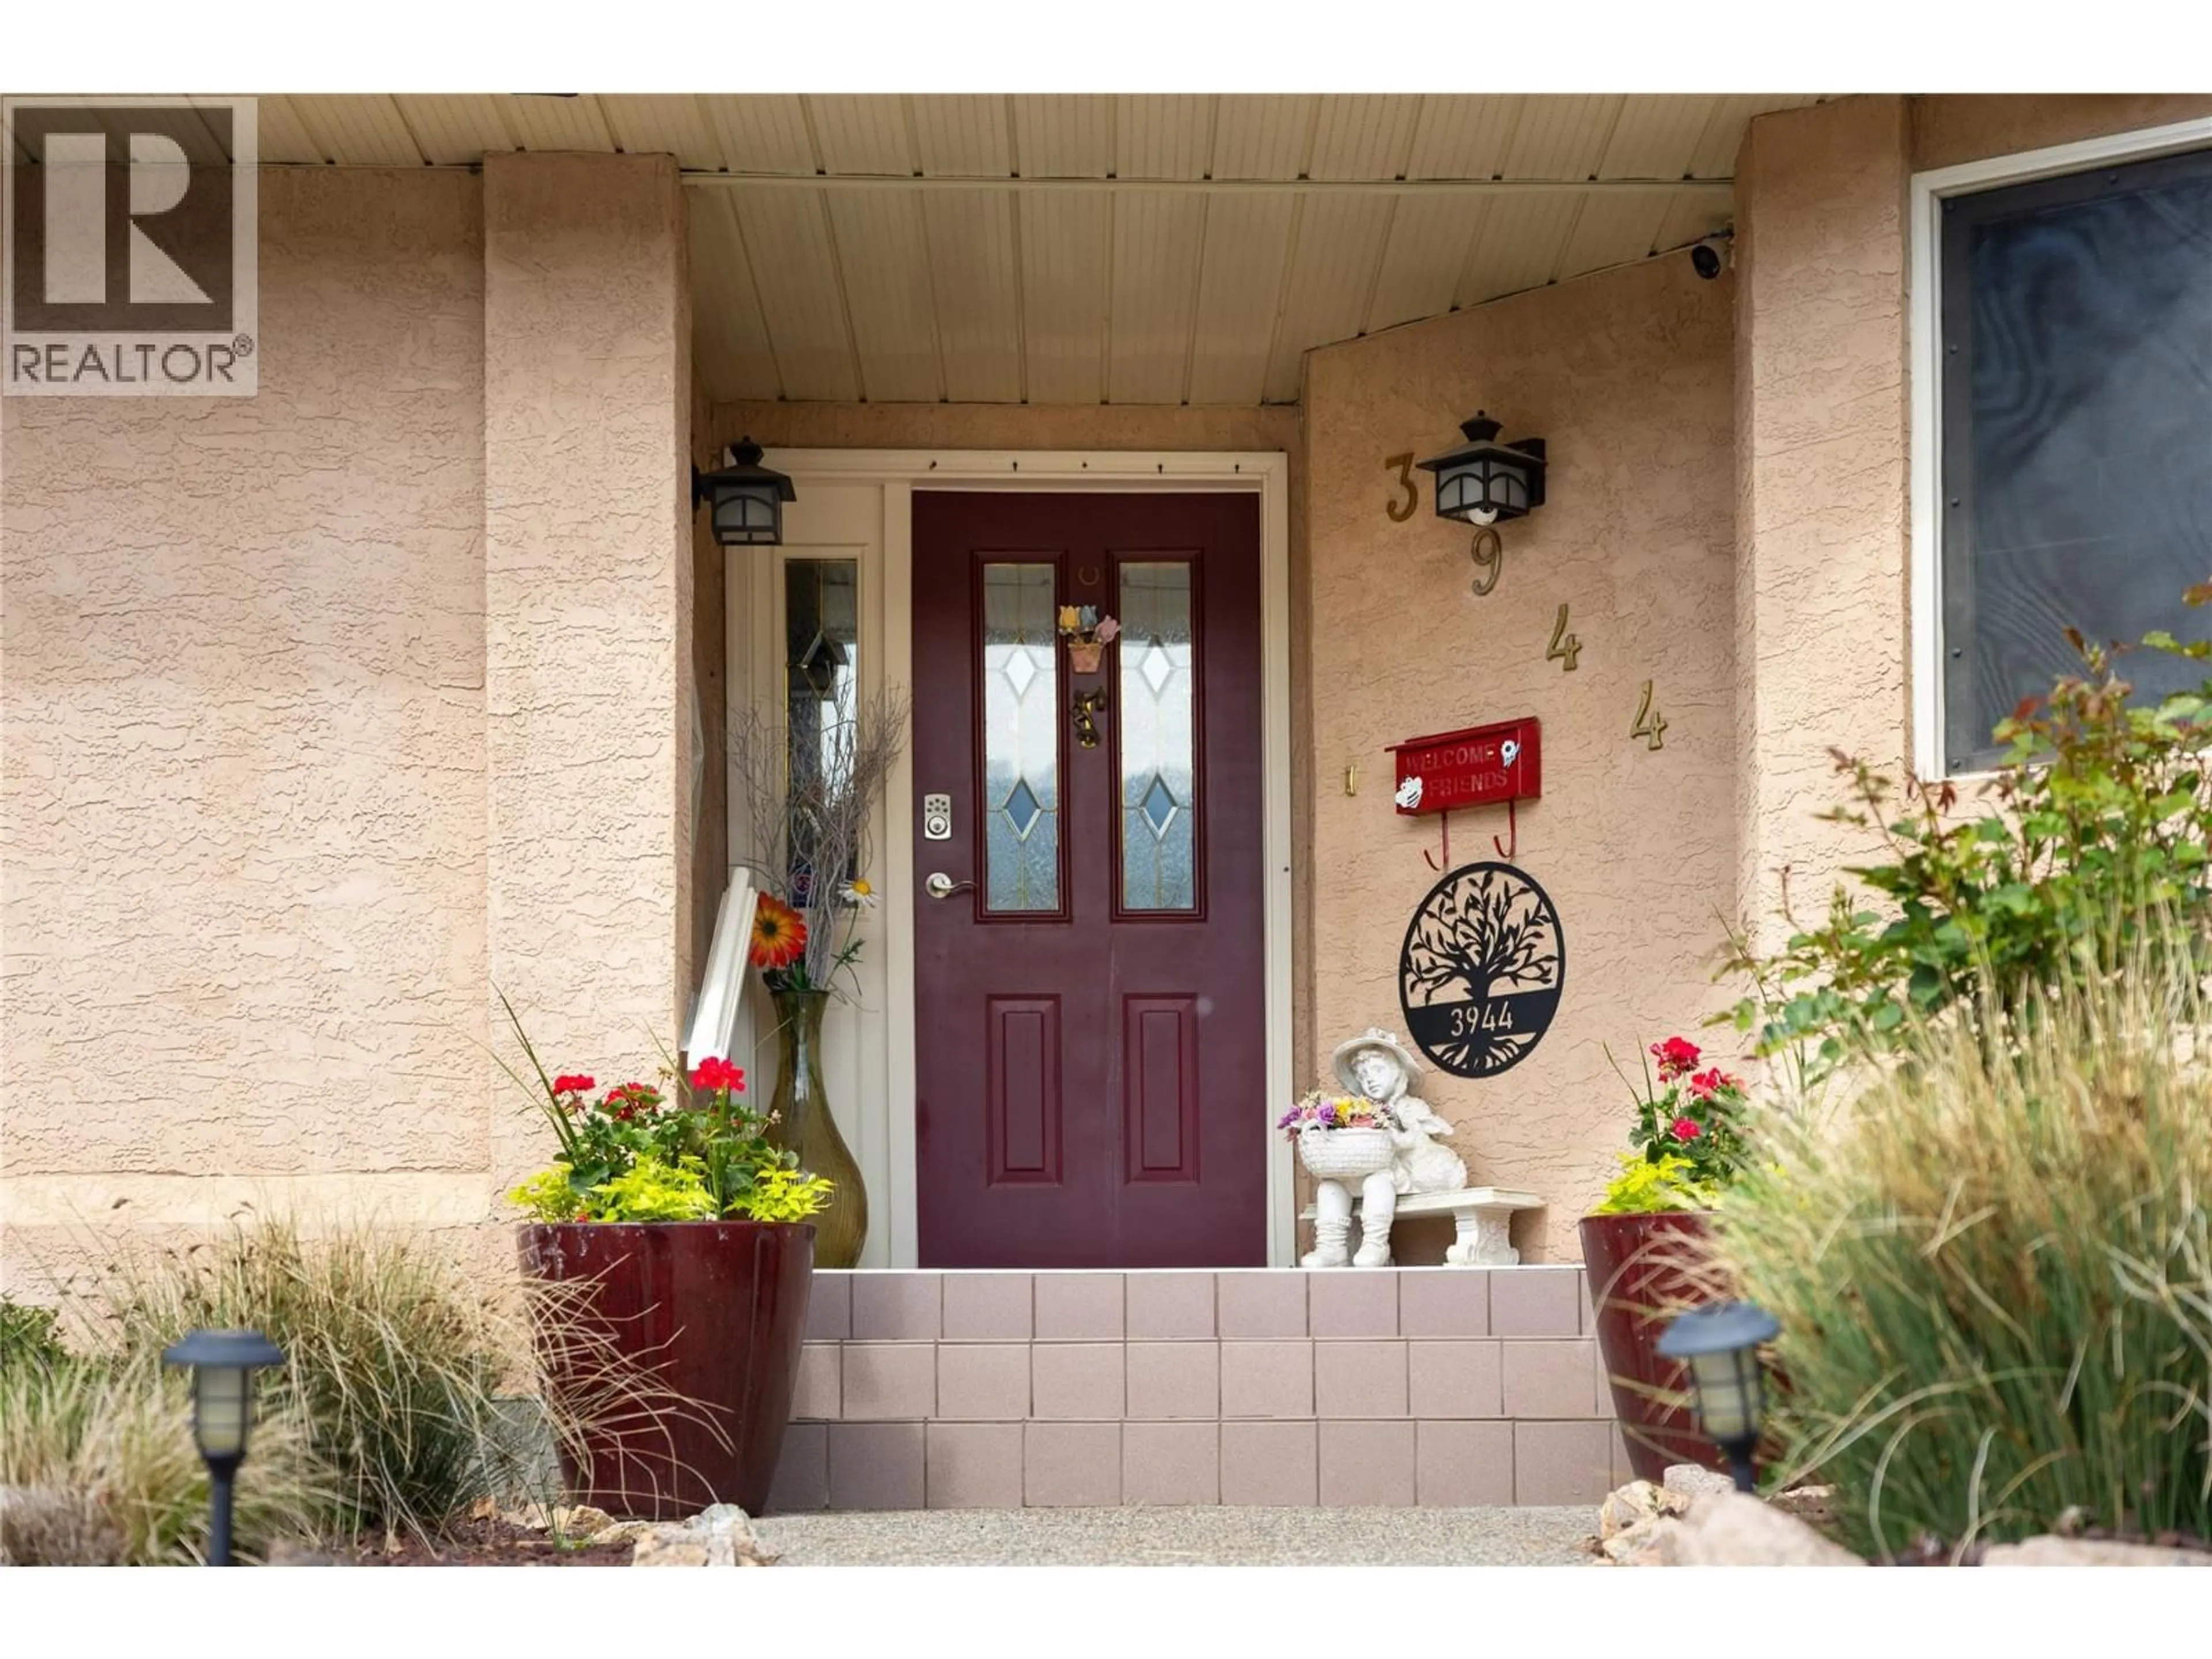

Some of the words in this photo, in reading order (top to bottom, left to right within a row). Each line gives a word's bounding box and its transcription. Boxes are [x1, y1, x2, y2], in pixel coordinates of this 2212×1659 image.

[1406, 744, 1495, 771] WELCOME
[1429, 770, 1508, 797] FRIENDS
[1450, 1001, 1513, 1036] 3944
